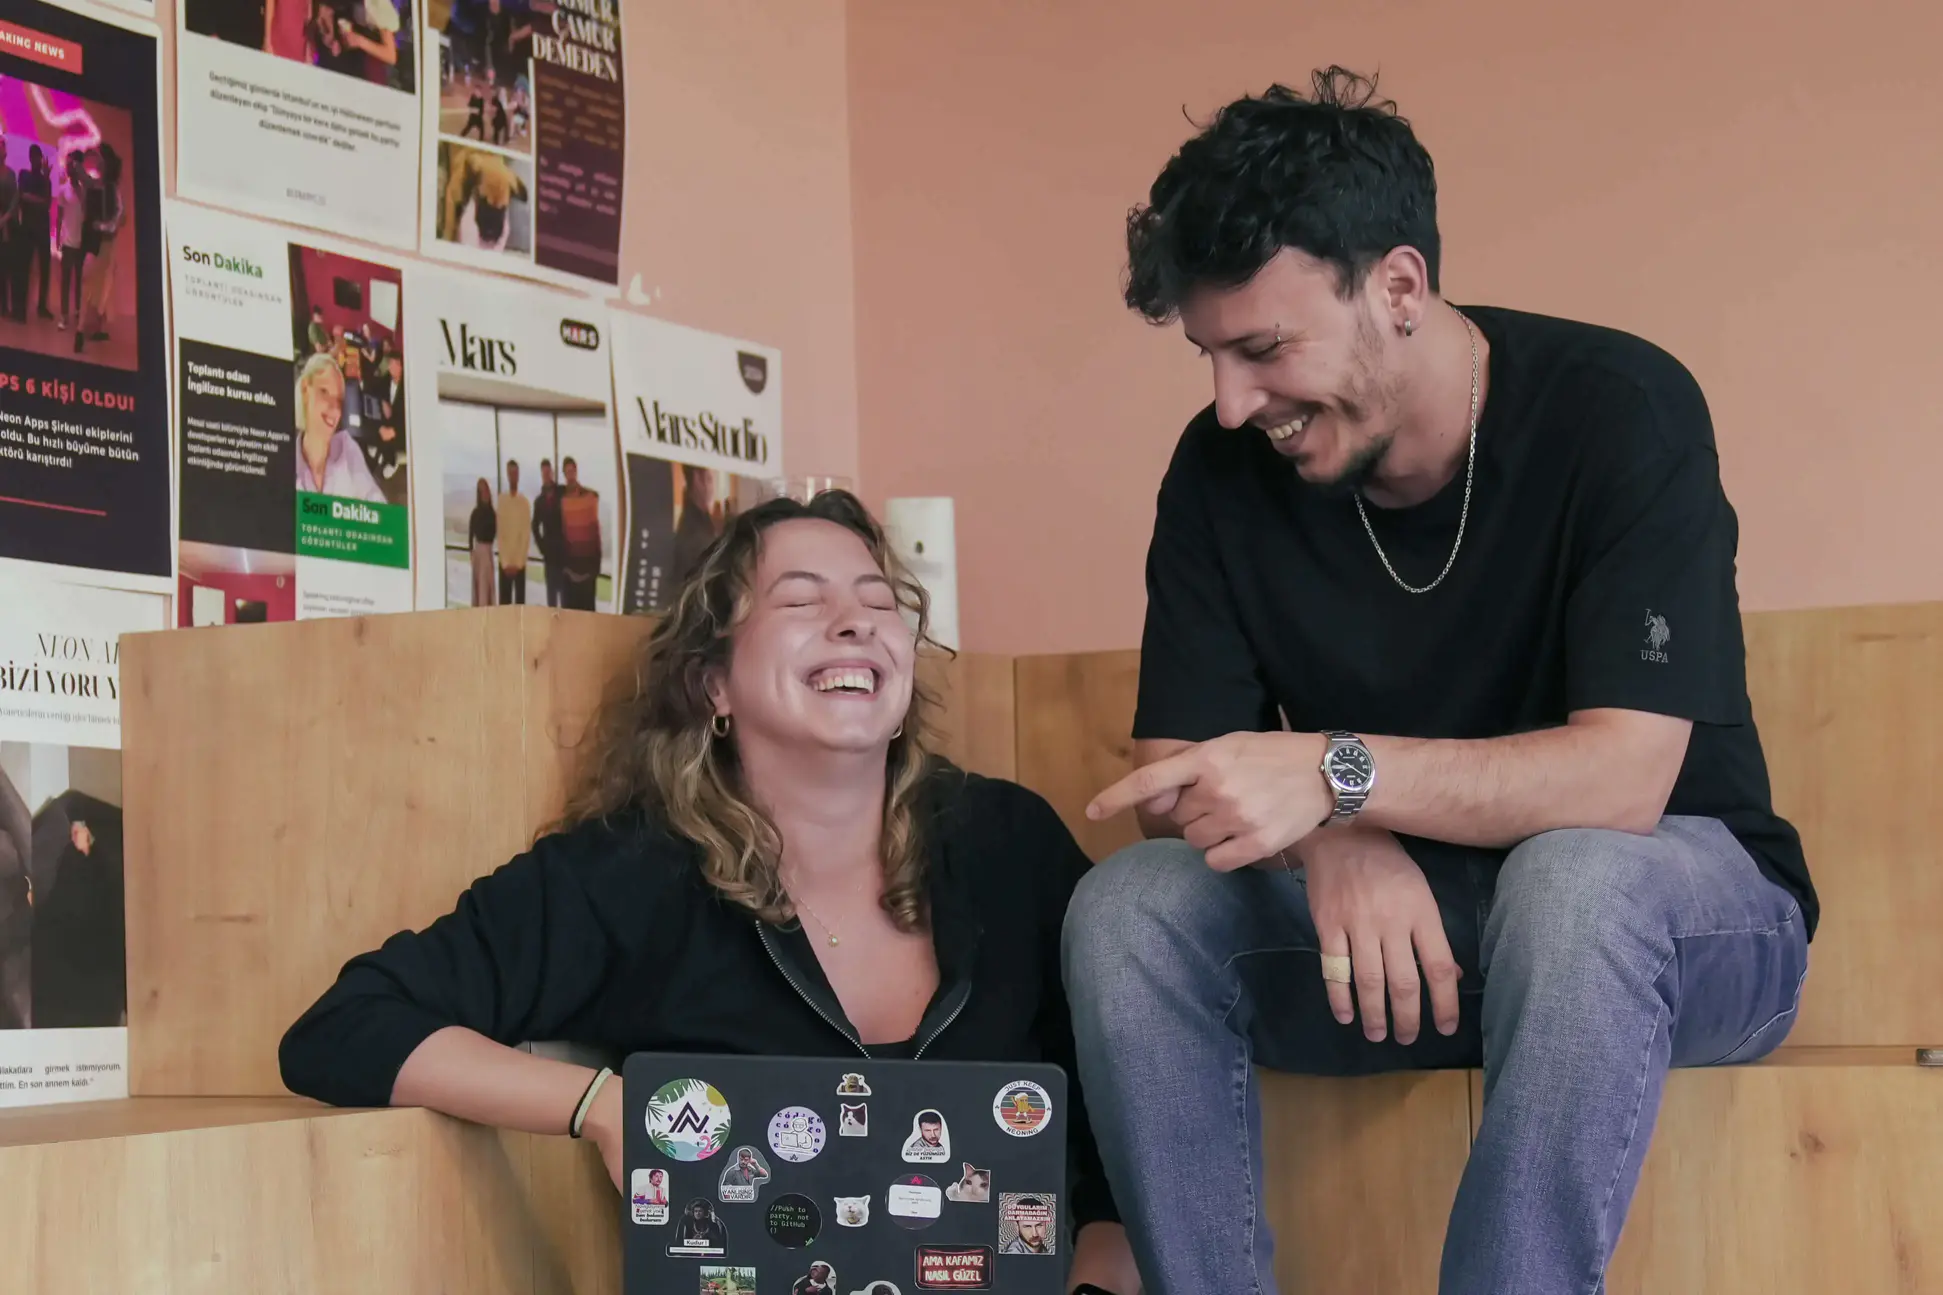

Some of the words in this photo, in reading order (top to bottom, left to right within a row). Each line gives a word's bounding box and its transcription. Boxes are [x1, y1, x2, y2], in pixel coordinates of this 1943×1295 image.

[34, 40, 65, 60] NEWS
[183, 245, 210, 266] Son
[213, 252, 263, 279] Dakika
[437, 318, 517, 377] Mars
[41, 378, 75, 404] KİŞİ
[81, 388, 135, 412] OLDU!
[24, 415, 49, 431] Apps
[51, 419, 83, 436] Şirketi
[85, 426, 133, 444] ekiplerini
[1, 428, 25, 443] oldu.
[27, 432, 41, 446] Bu
[43, 435, 64, 450] hızlı
[66, 441, 106, 457] büyüme
[108, 447, 140, 461] bütün
[302, 498, 328, 516] Son
[332, 501, 380, 524] Dakika
[301, 522, 343, 537] TOPLANTI
[1640, 649, 1669, 663] USPA
[44, 1064, 70, 1076] girmek
[18, 1080, 28, 1090] En
[30, 1080, 43, 1089] son
[45, 1079, 70, 1088] annem
[1004, 1081, 1021, 1091] JUST
[1023, 1081, 1041, 1091] KEEP
[1006, 1126, 1039, 1136] NEONING
[922, 1255, 944, 1267] AMA
[945, 1255, 984, 1267] KAFAMIZ
[925, 1269, 951, 1282] NASIL
[952, 1268, 982, 1282] GÜZEL
